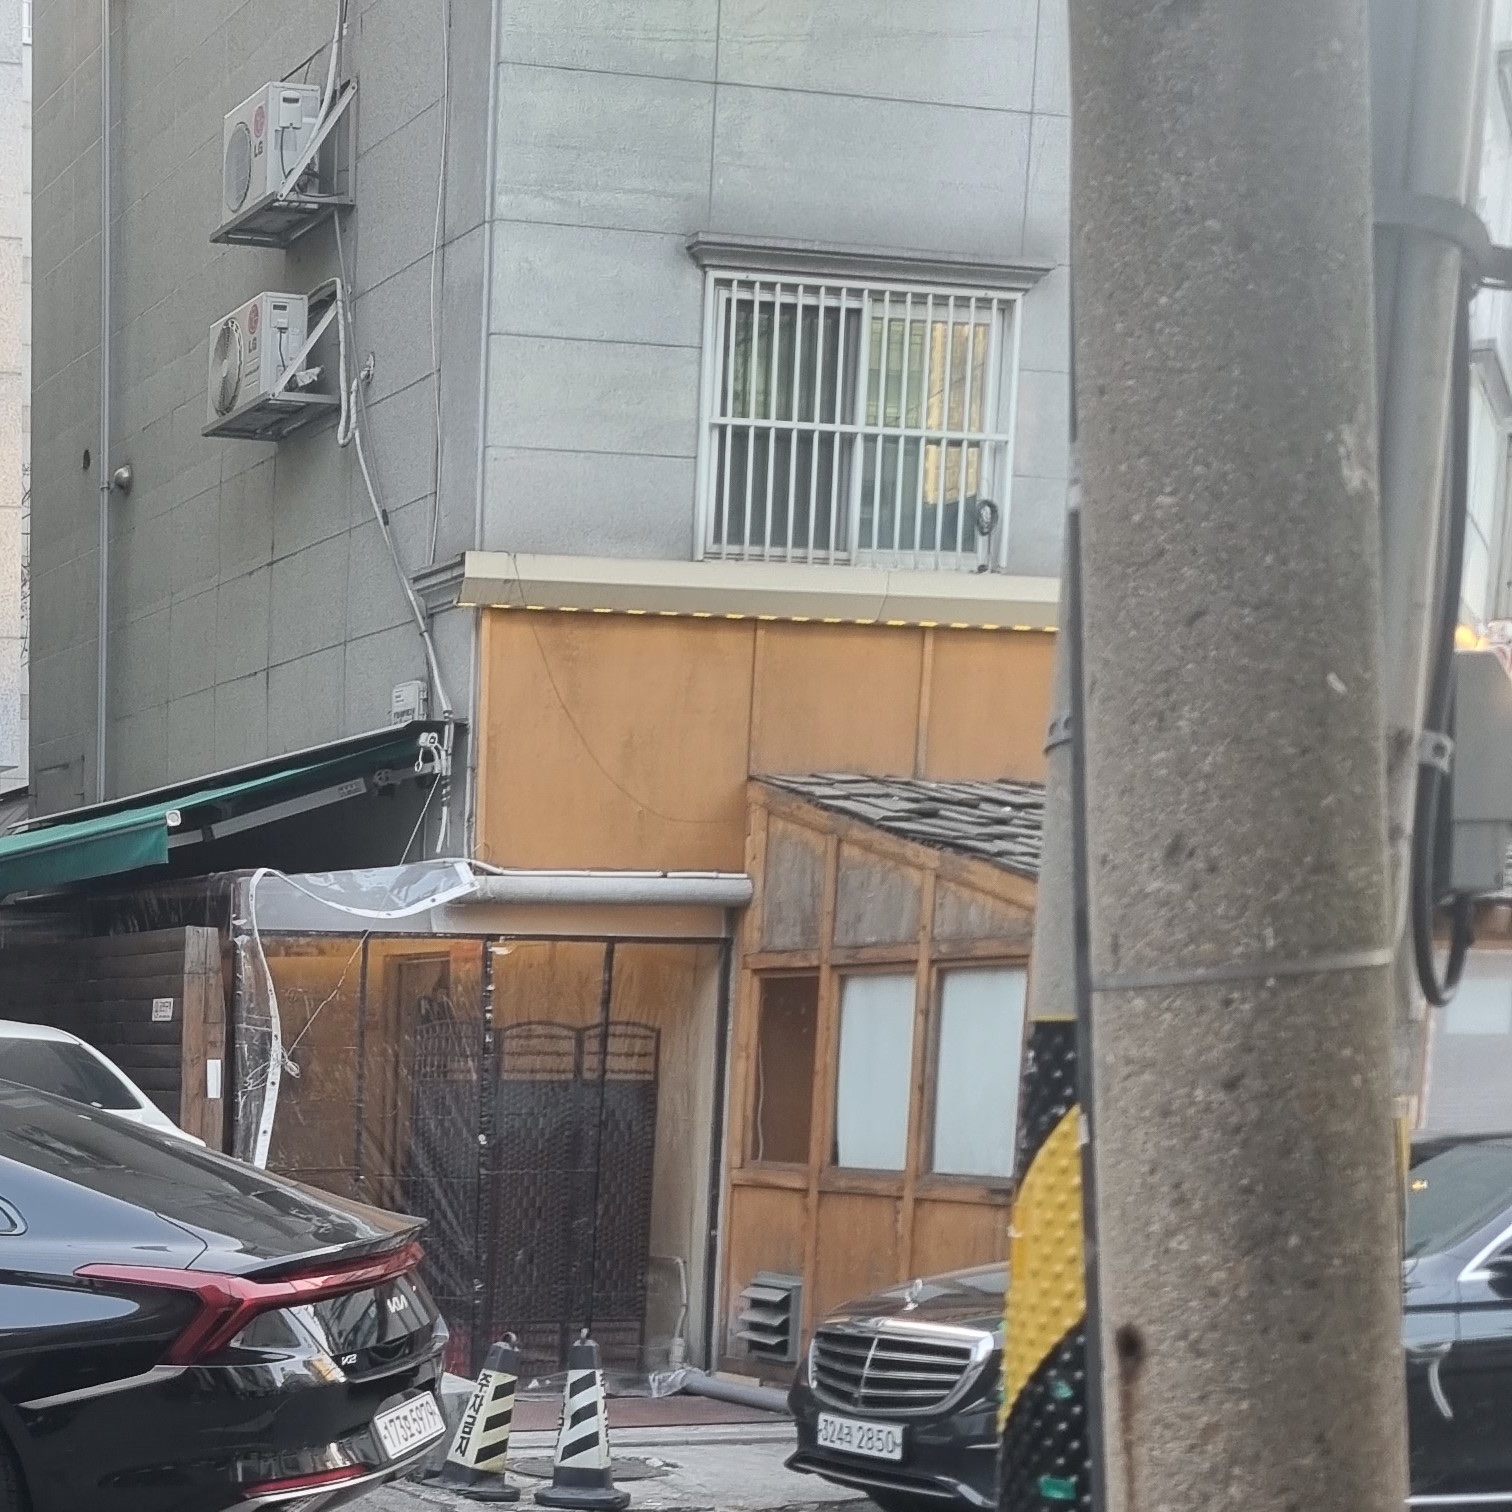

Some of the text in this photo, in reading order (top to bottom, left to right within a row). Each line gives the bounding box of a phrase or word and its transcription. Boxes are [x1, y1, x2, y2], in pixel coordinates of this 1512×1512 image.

[253, 140, 264, 158] LG
[248, 336, 258, 354] LG
[856, 1425, 894, 1454] 2850
